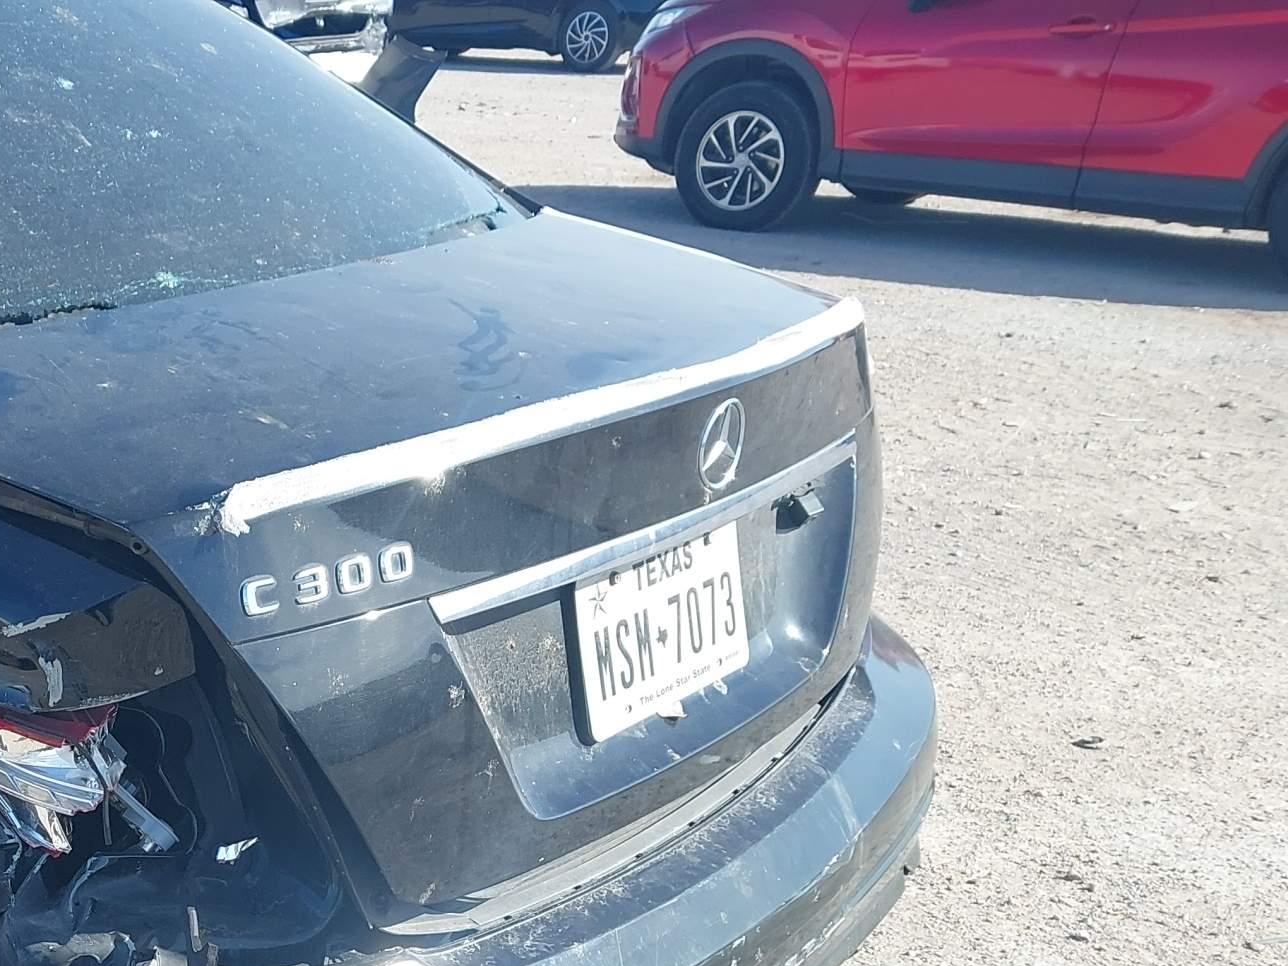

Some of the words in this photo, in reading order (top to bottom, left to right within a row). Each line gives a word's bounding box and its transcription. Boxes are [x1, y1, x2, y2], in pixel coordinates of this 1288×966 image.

[240, 575, 280, 617] C
[292, 541, 413, 606] 300
[632, 540, 693, 591] TEXAS
[639, 693, 654, 705] The
[655, 682, 674, 698] Lone
[675, 674, 691, 688] Star
[692, 663, 711, 679] State
